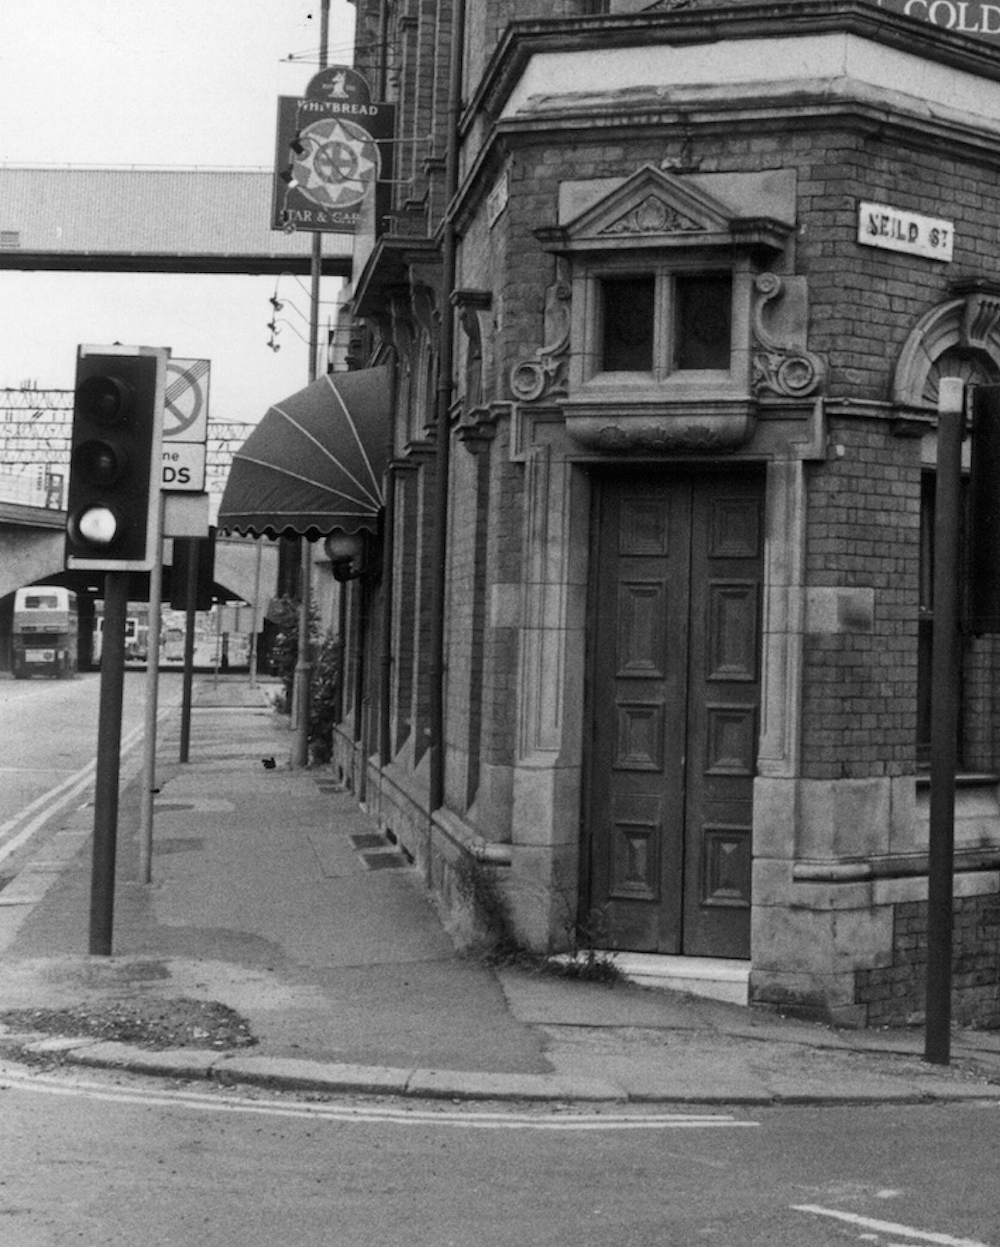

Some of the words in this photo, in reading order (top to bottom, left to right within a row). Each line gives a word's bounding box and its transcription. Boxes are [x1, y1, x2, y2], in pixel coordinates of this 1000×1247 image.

[316, 210, 328, 223] &
[162, 452, 179, 462] ne
[163, 466, 190, 484] DS
